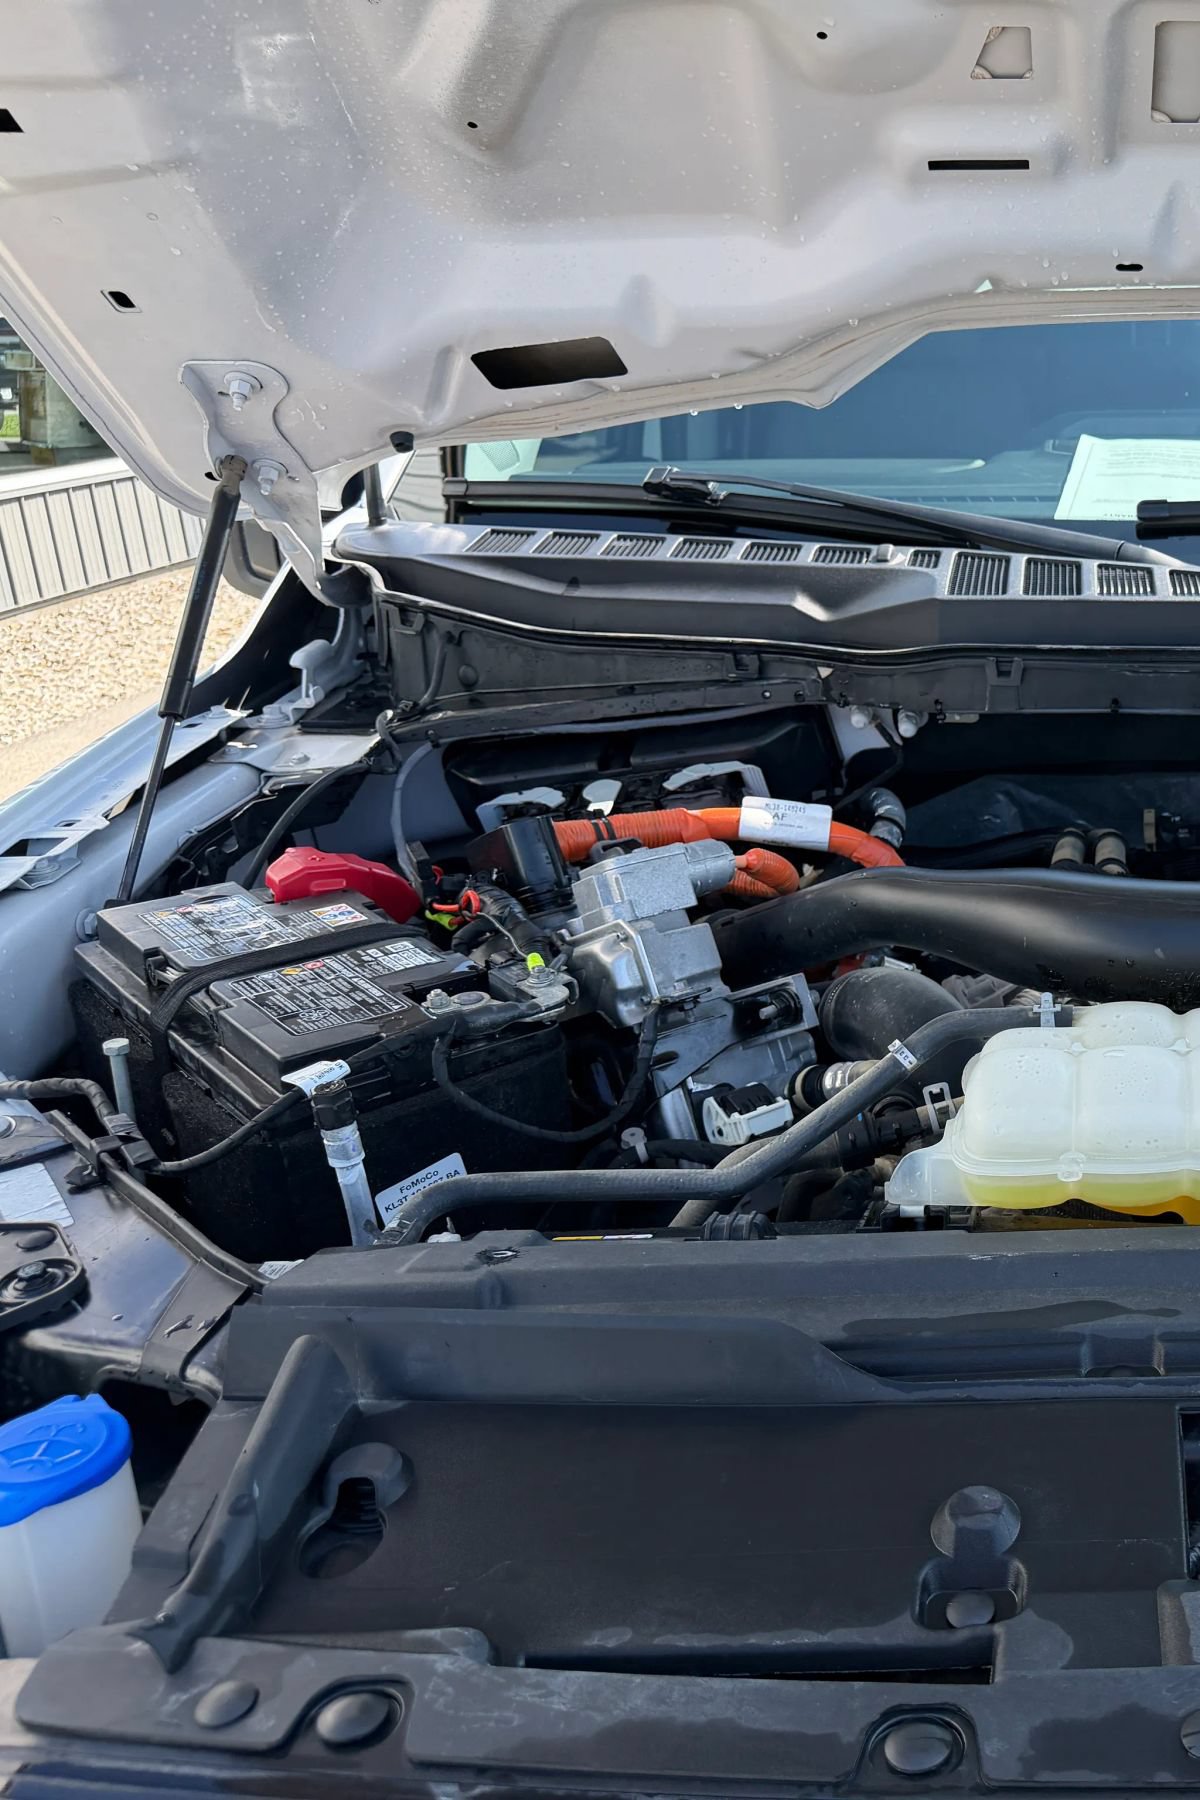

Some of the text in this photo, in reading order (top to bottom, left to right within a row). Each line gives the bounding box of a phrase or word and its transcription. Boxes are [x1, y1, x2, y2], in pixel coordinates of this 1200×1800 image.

[773, 812, 787, 821] AF
[384, 1169, 461, 1213] KL3T BA
[399, 1170, 439, 1194] FoMoCo
